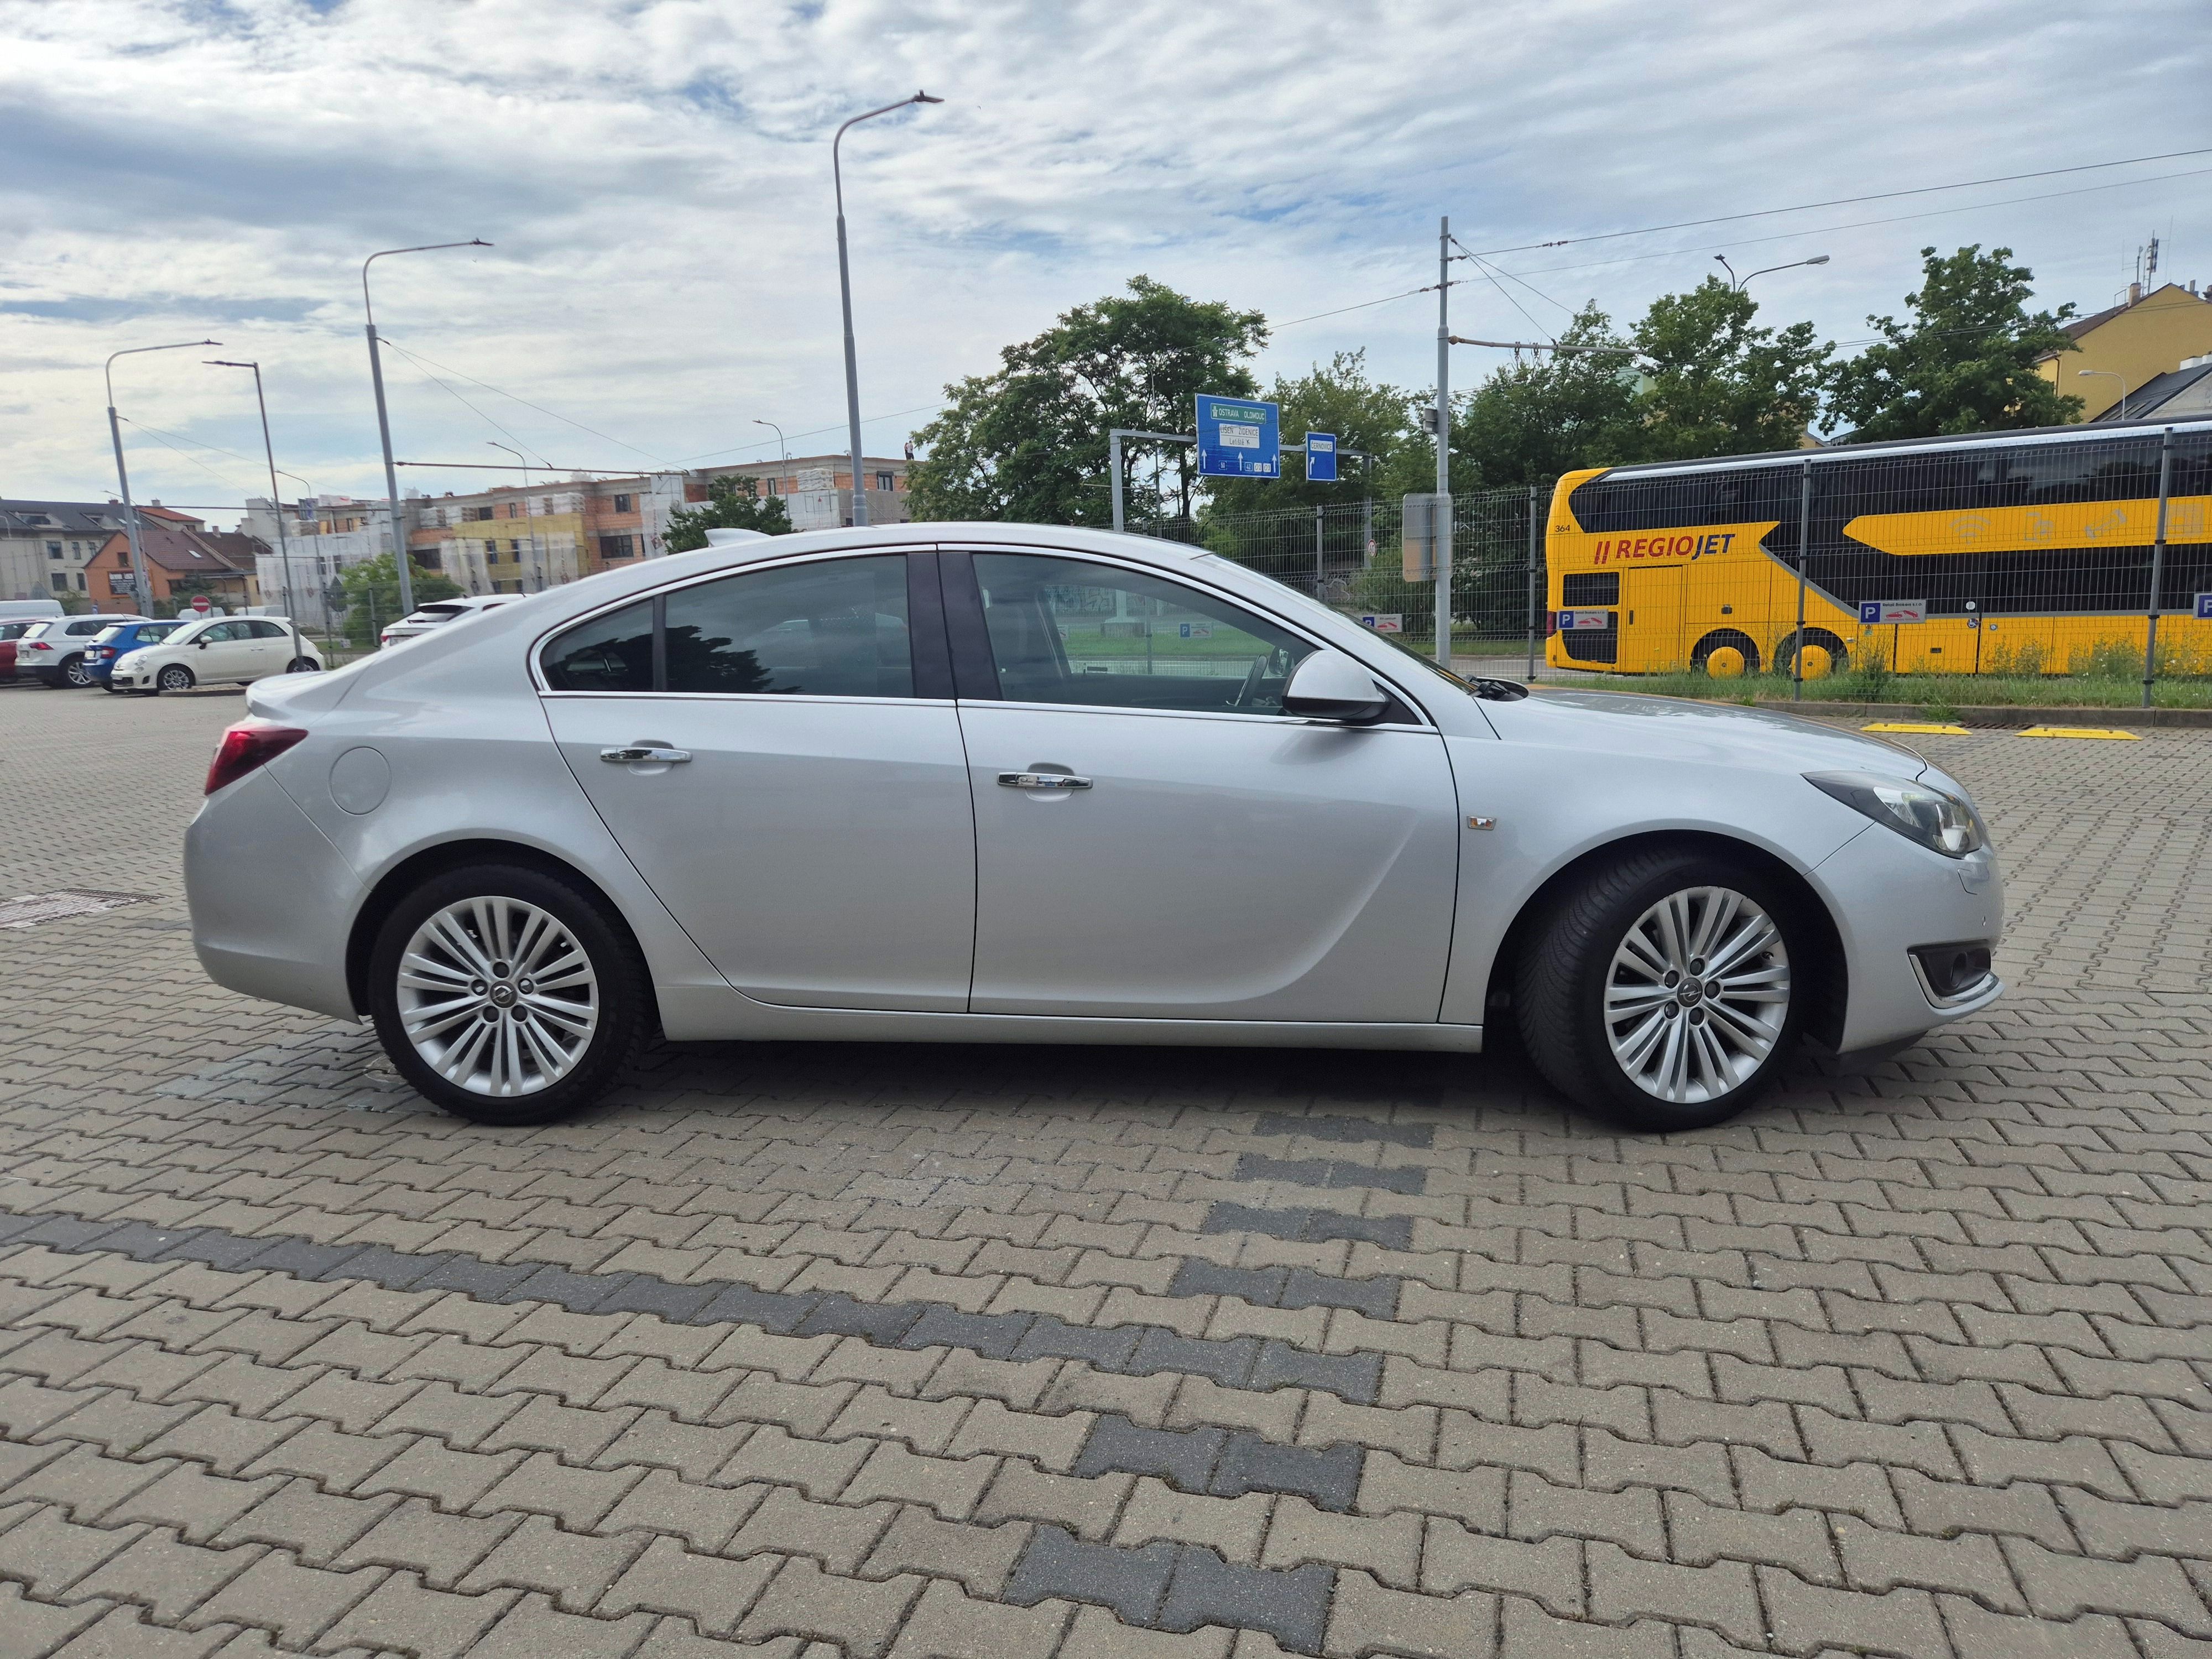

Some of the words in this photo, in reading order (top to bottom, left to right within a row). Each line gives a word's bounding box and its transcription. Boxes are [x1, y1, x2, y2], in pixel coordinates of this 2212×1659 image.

[1219, 408, 1239, 418] OSTRAVA
[1244, 411, 1265, 420] OLOMOUC
[1616, 534, 1735, 561] REGIOJET
[1865, 607, 1876, 619] P
[1562, 614, 1571, 625] P
[1182, 627, 1188, 635] P
